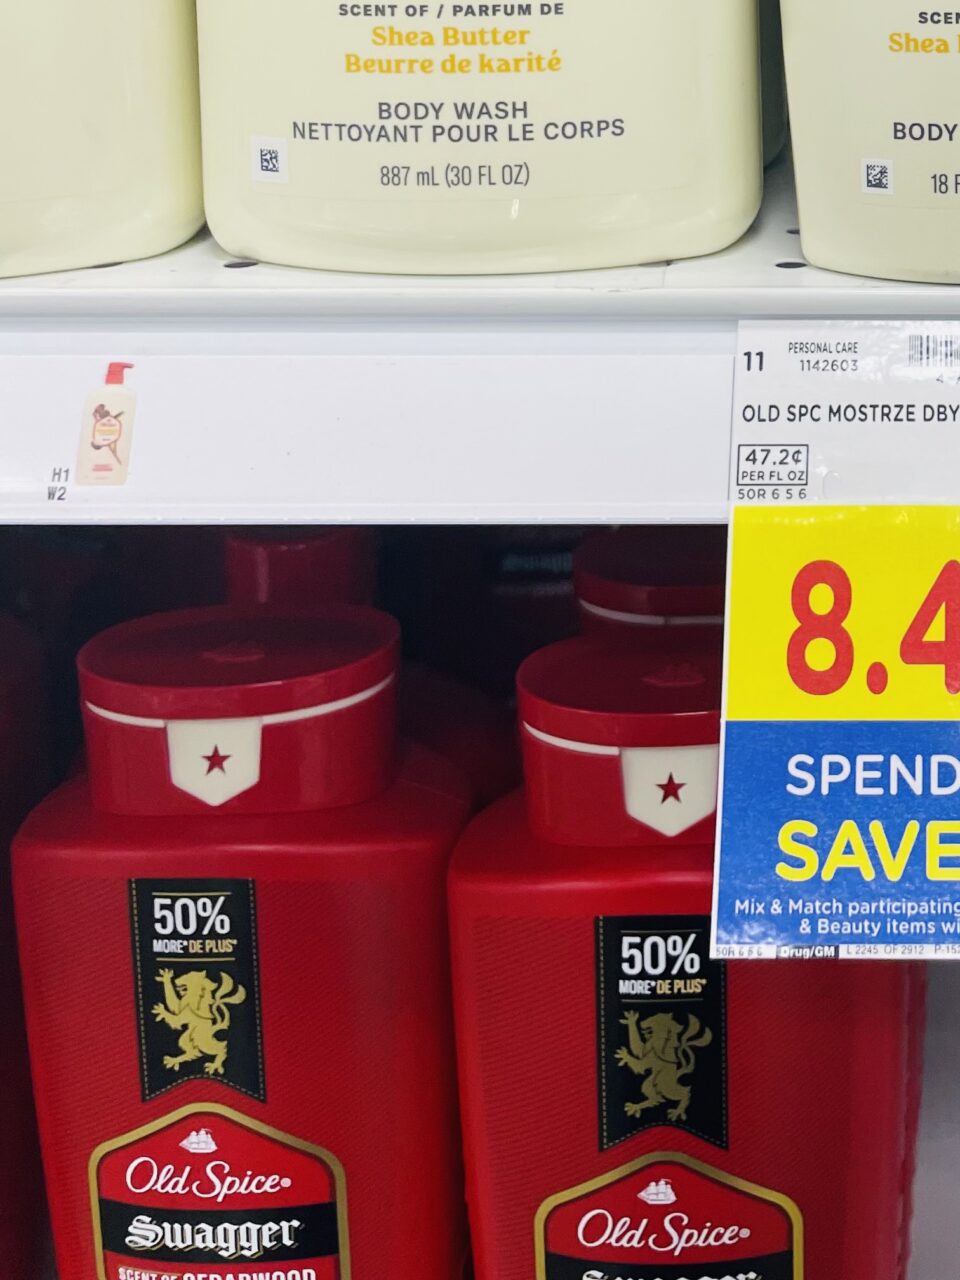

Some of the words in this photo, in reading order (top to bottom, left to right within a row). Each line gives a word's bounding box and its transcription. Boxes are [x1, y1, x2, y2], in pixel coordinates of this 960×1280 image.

[338, 3, 398, 17] SCENT
[404, 3, 429, 17] OF
[452, 2, 532, 17] PARFUM
[539, 1, 564, 16] DE
[371, 26, 435, 47] Shea
[442, 26, 531, 46] Butter
[888, 32, 950, 53] Shea
[344, 53, 435, 74] Beurre
[440, 53, 471, 74] de
[478, 49, 562, 74] karité
[377, 102, 444, 120] BODY
[453, 101, 528, 119] WASH
[292, 122, 423, 143] NETTOYANT
[432, 124, 498, 143] POUR
[507, 123, 534, 142] LE
[543, 119, 625, 140] CORPS
[893, 122, 959, 141] BODY
[379, 165, 411, 186] 887
[416, 165, 439, 186] mL
[444, 163, 472, 188] (30
[478, 165, 497, 186] FL
[501, 161, 530, 187] OZ)
[930, 174, 949, 194] 18
[788, 342, 833, 354] PERSONAL
[835, 342, 858, 354] CARE
[743, 351, 764, 372] 11
[800, 359, 858, 372] 1142603
[742, 404, 780, 422] OLD
[787, 404, 821, 422] SPC
[828, 404, 916, 422] MOSTRZE
[923, 404, 960, 422] DBY
[745, 448, 802, 465] 47.2¢
[51, 468, 70, 482] H1
[742, 470, 765, 481] PER
[769, 471, 783, 481] FL
[788, 471, 805, 481] OZ
[47, 487, 67, 501] W2
[153, 896, 231, 935] 50%
[735, 898, 765, 914] Mix
[789, 898, 842, 914] Match
[817, 918, 881, 937] Beauty
[886, 918, 935, 934] items
[189, 940, 204, 953] DE
[621, 933, 700, 975] 50%
[780, 946, 835, 959] Drug/GM
[656, 979, 672, 994] DE
[125, 1156, 192, 1194] Old
[124, 1214, 304, 1259] Swagger
[577, 1209, 648, 1248] Old
